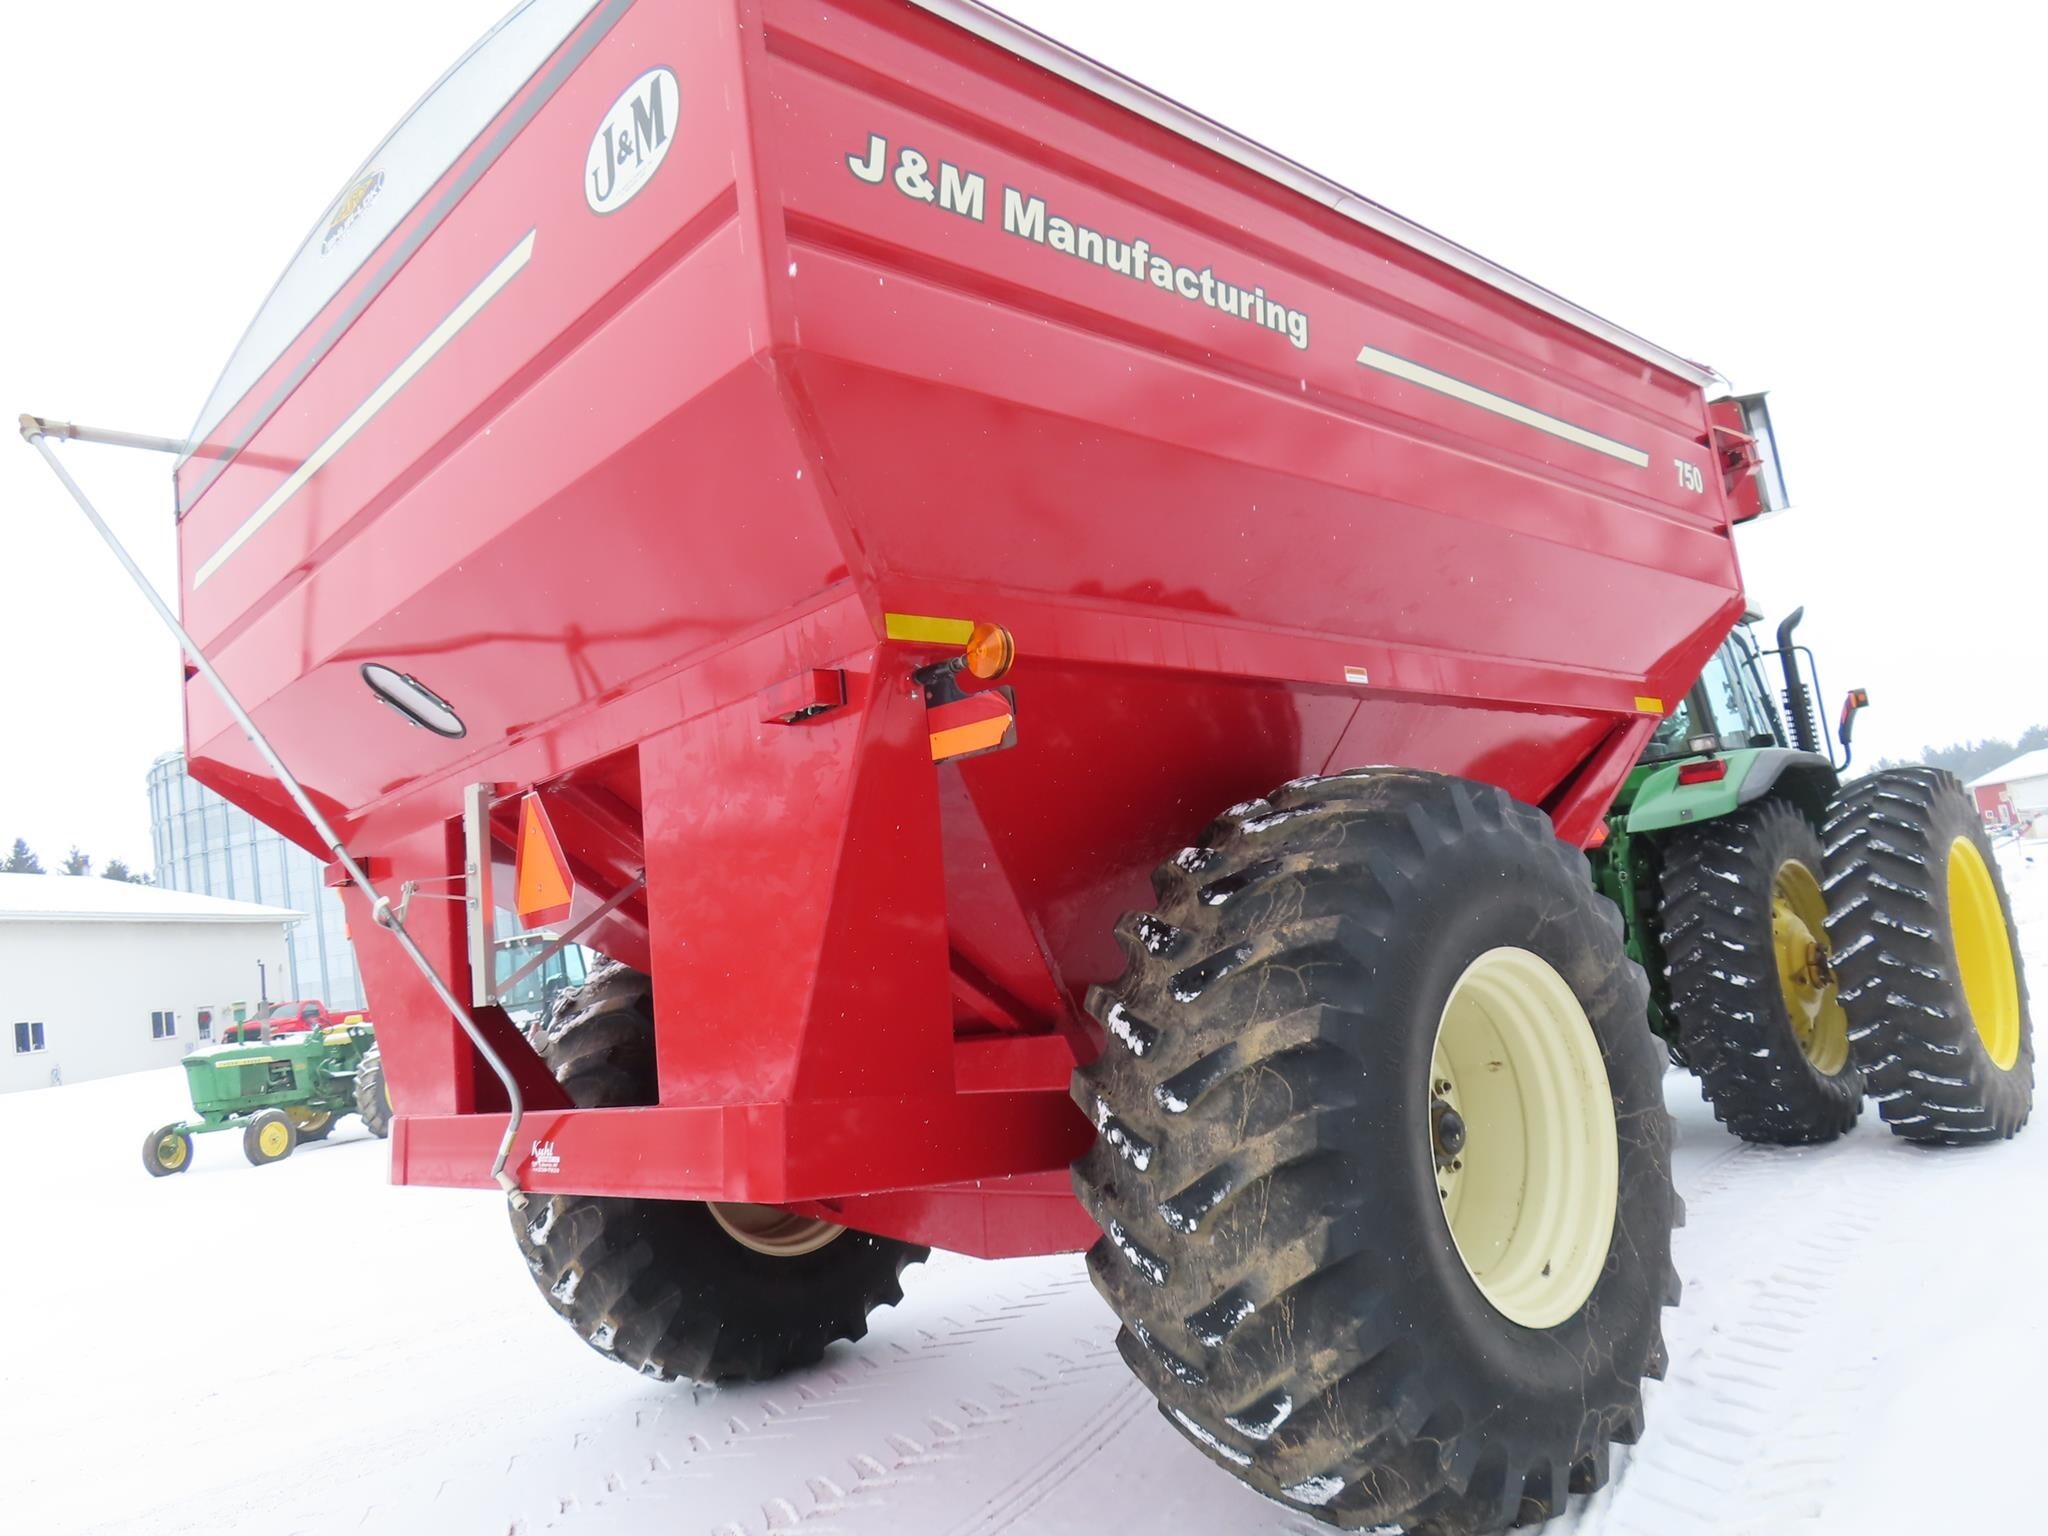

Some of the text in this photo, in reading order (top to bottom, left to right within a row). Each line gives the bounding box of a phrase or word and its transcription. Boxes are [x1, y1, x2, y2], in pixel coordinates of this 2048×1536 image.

[592, 73, 667, 202] J&M
[1002, 186, 1309, 350] Manufacturing
[1673, 458, 1704, 494] 750
[531, 1139, 554, 1157] Kuhl
